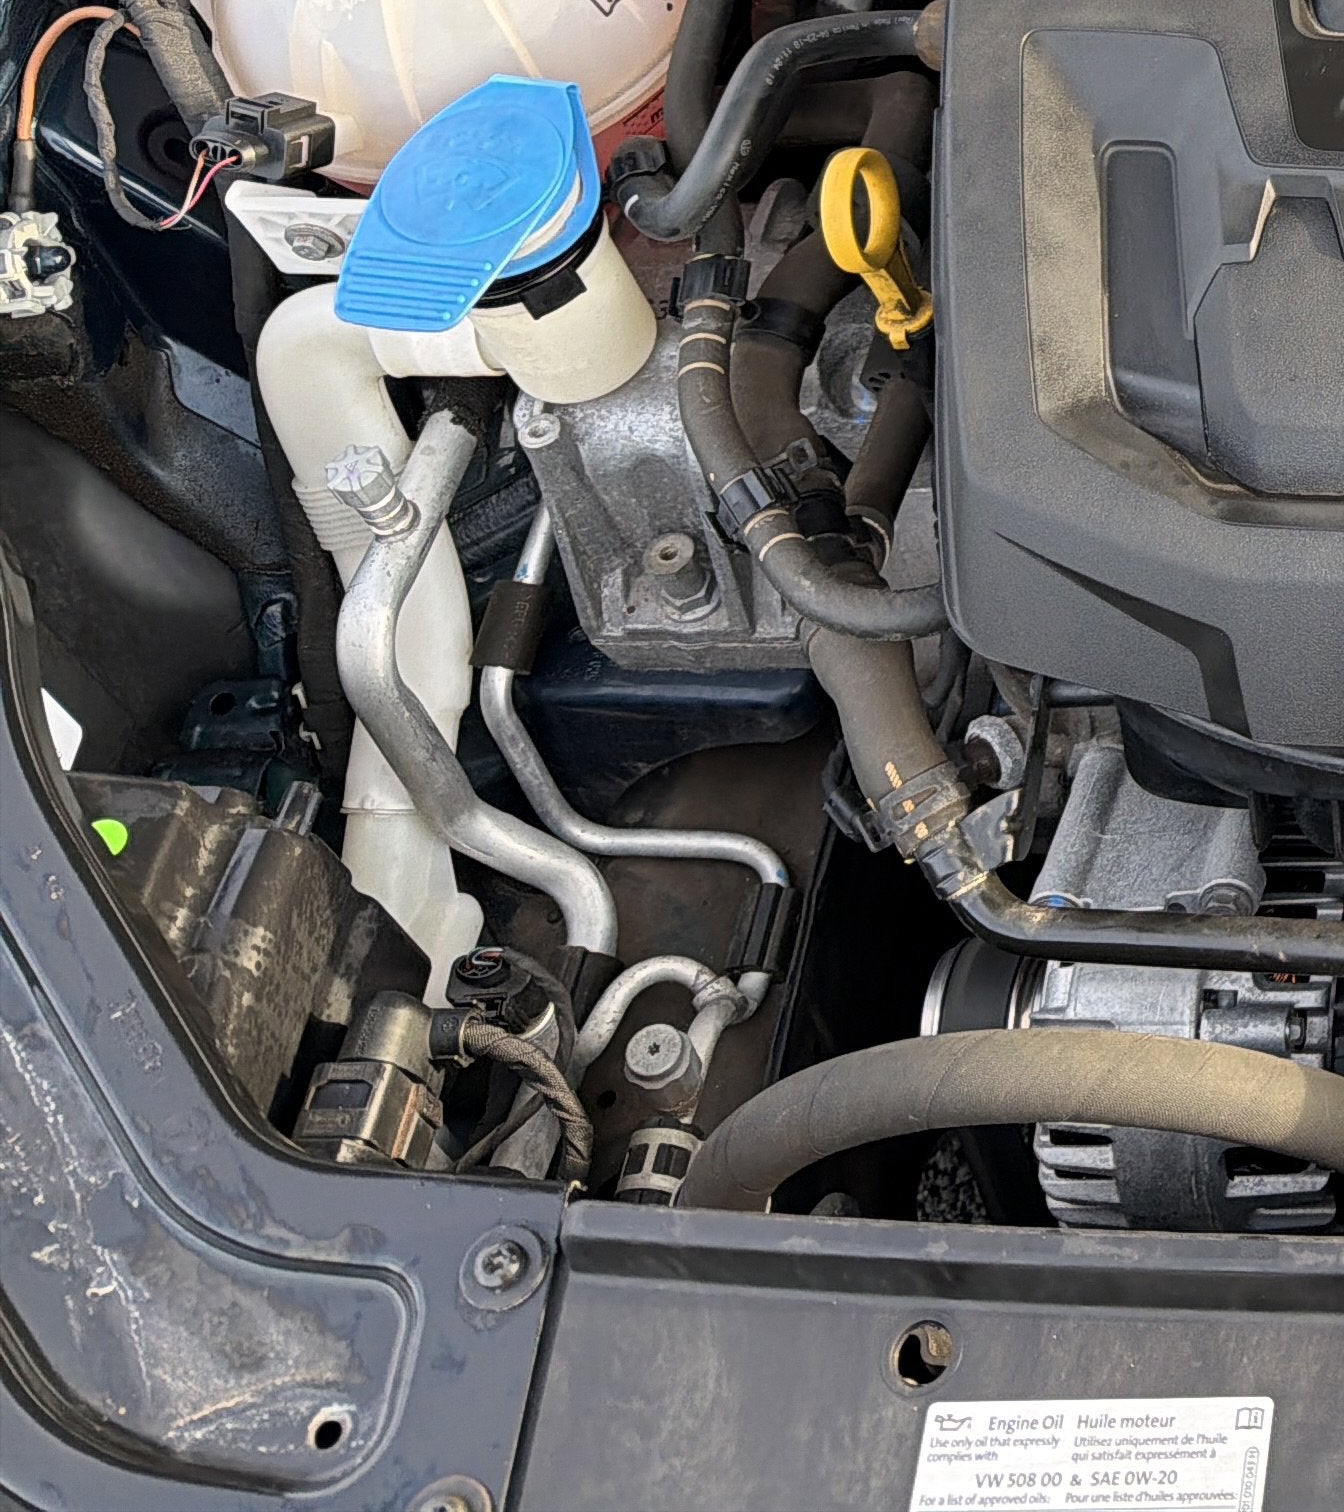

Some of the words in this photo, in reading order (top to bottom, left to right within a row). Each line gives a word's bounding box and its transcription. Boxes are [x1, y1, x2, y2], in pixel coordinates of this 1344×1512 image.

[989, 1416, 1038, 1434] Engine
[1043, 1415, 1063, 1430] Oil
[1077, 1415, 1116, 1429] Huile
[1120, 1415, 1175, 1428] moteur
[930, 1438, 949, 1448] Use
[951, 1436, 973, 1450] only
[975, 1436, 987, 1447] oil
[990, 1436, 1011, 1447] that
[1013, 1435, 1060, 1449] expressly
[1074, 1436, 1112, 1447] Utilisez
[1115, 1435, 1178, 1448] uniquement
[1181, 1434, 1194, 1444] de
[927, 1453, 972, 1464] complies
[975, 1451, 998, 1461] with
[1072, 1451, 1088, 1463] qui
[1091, 1449, 1131, 1460] satisfait
[1135, 1448, 1207, 1462] expressément
[976, 1474, 1004, 1487] VW
[1007, 1473, 1036, 1488] 508
[1041, 1472, 1062, 1486] 00
[1070, 1474, 1081, 1486] &
[1091, 1471, 1120, 1486] SAE
[1125, 1470, 1177, 1485] 0W-20
[919, 1495, 936, 1506] For
[938, 1497, 944, 1505] a
[948, 1494, 962, 1505] list
[965, 1493, 977, 1505] of
[978, 1493, 1027, 1507] approved
[1065, 1493, 1088, 1503] Pour
[1091, 1493, 1110, 1502] une
[1113, 1491, 1133, 1501] liste
